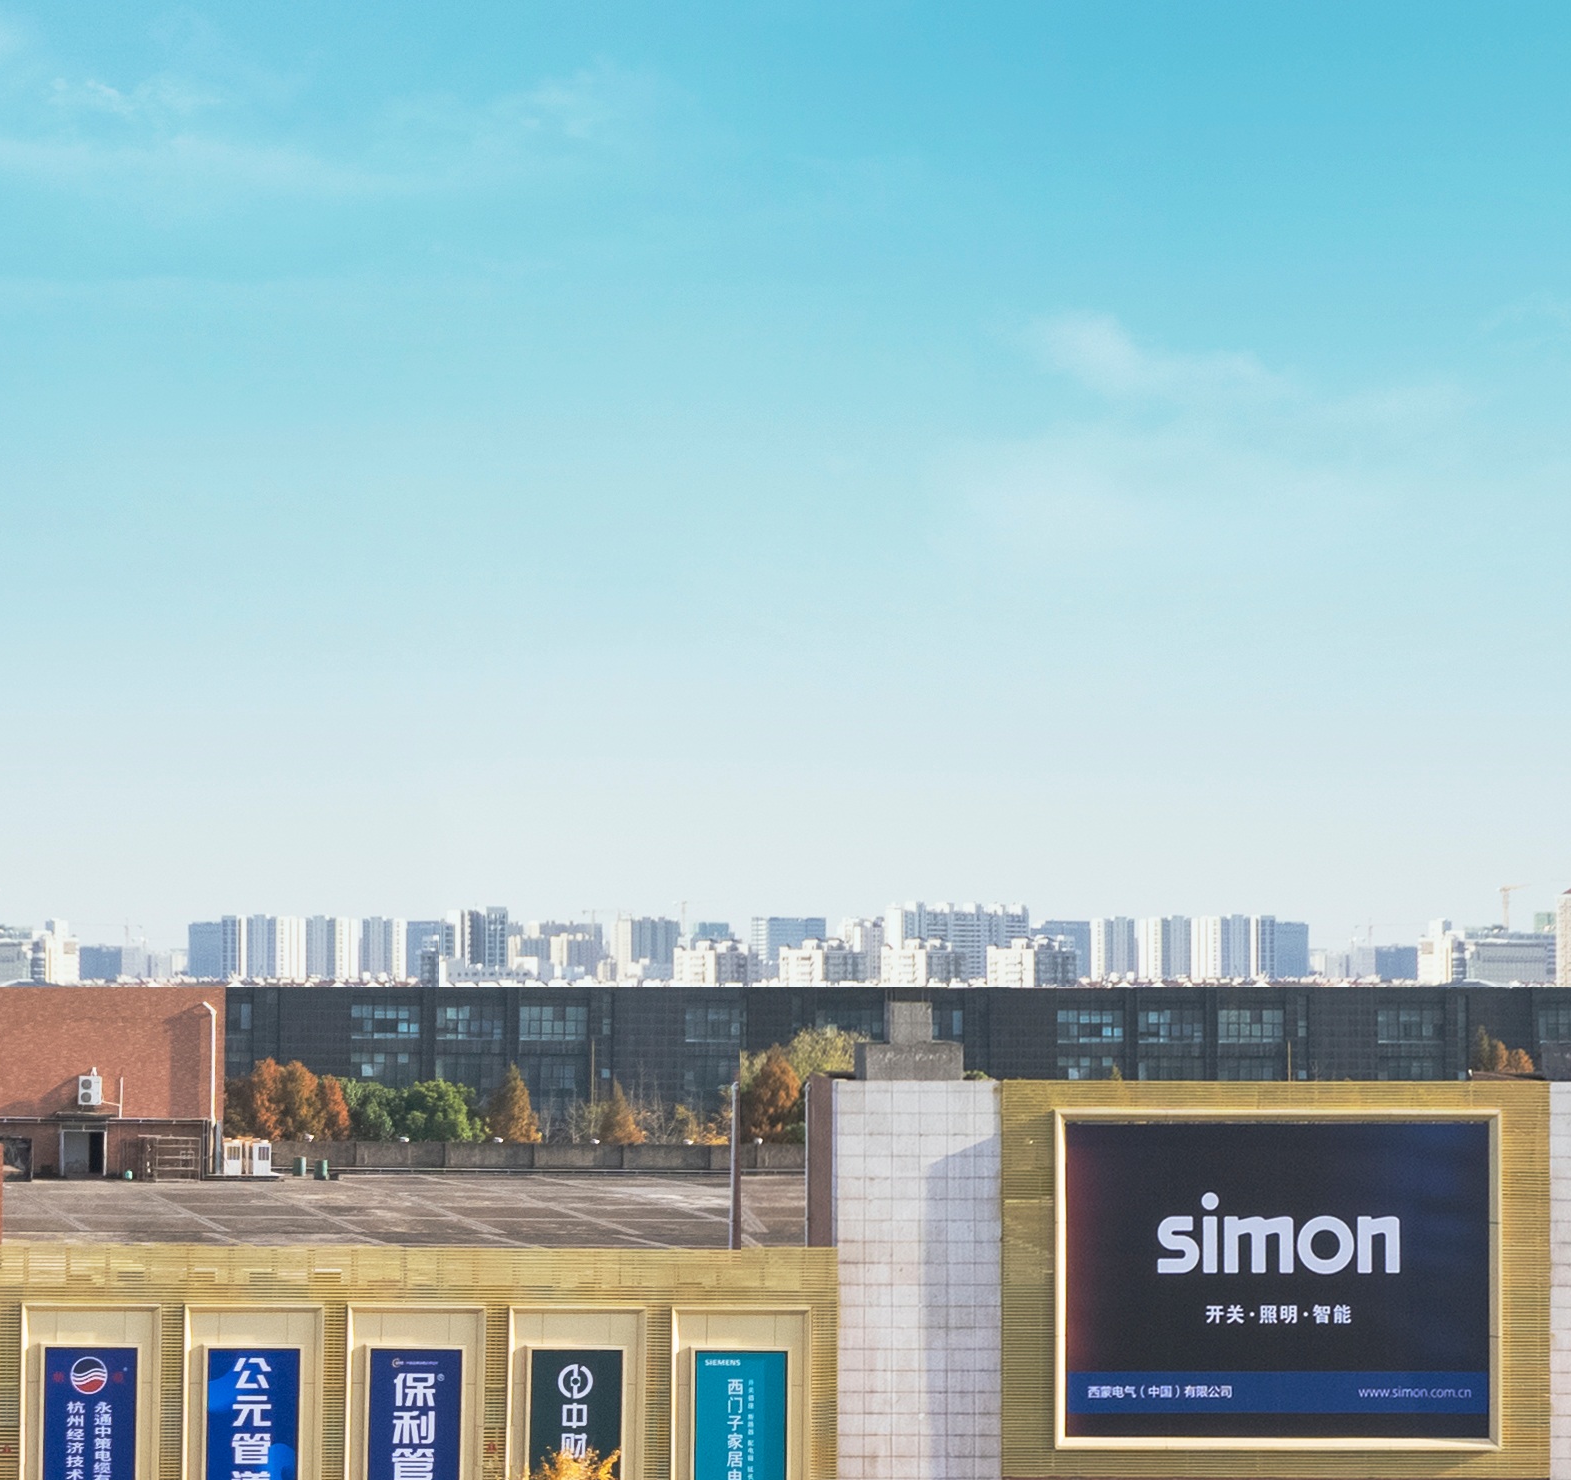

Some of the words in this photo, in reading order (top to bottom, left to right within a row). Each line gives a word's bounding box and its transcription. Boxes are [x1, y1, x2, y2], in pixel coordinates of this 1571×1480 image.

[1156, 1191, 1401, 1275] simon
[1205, 1303, 1352, 1325] 开关·照明·智能
[1358, 1386, 1472, 1400] www.simon.com.cn
